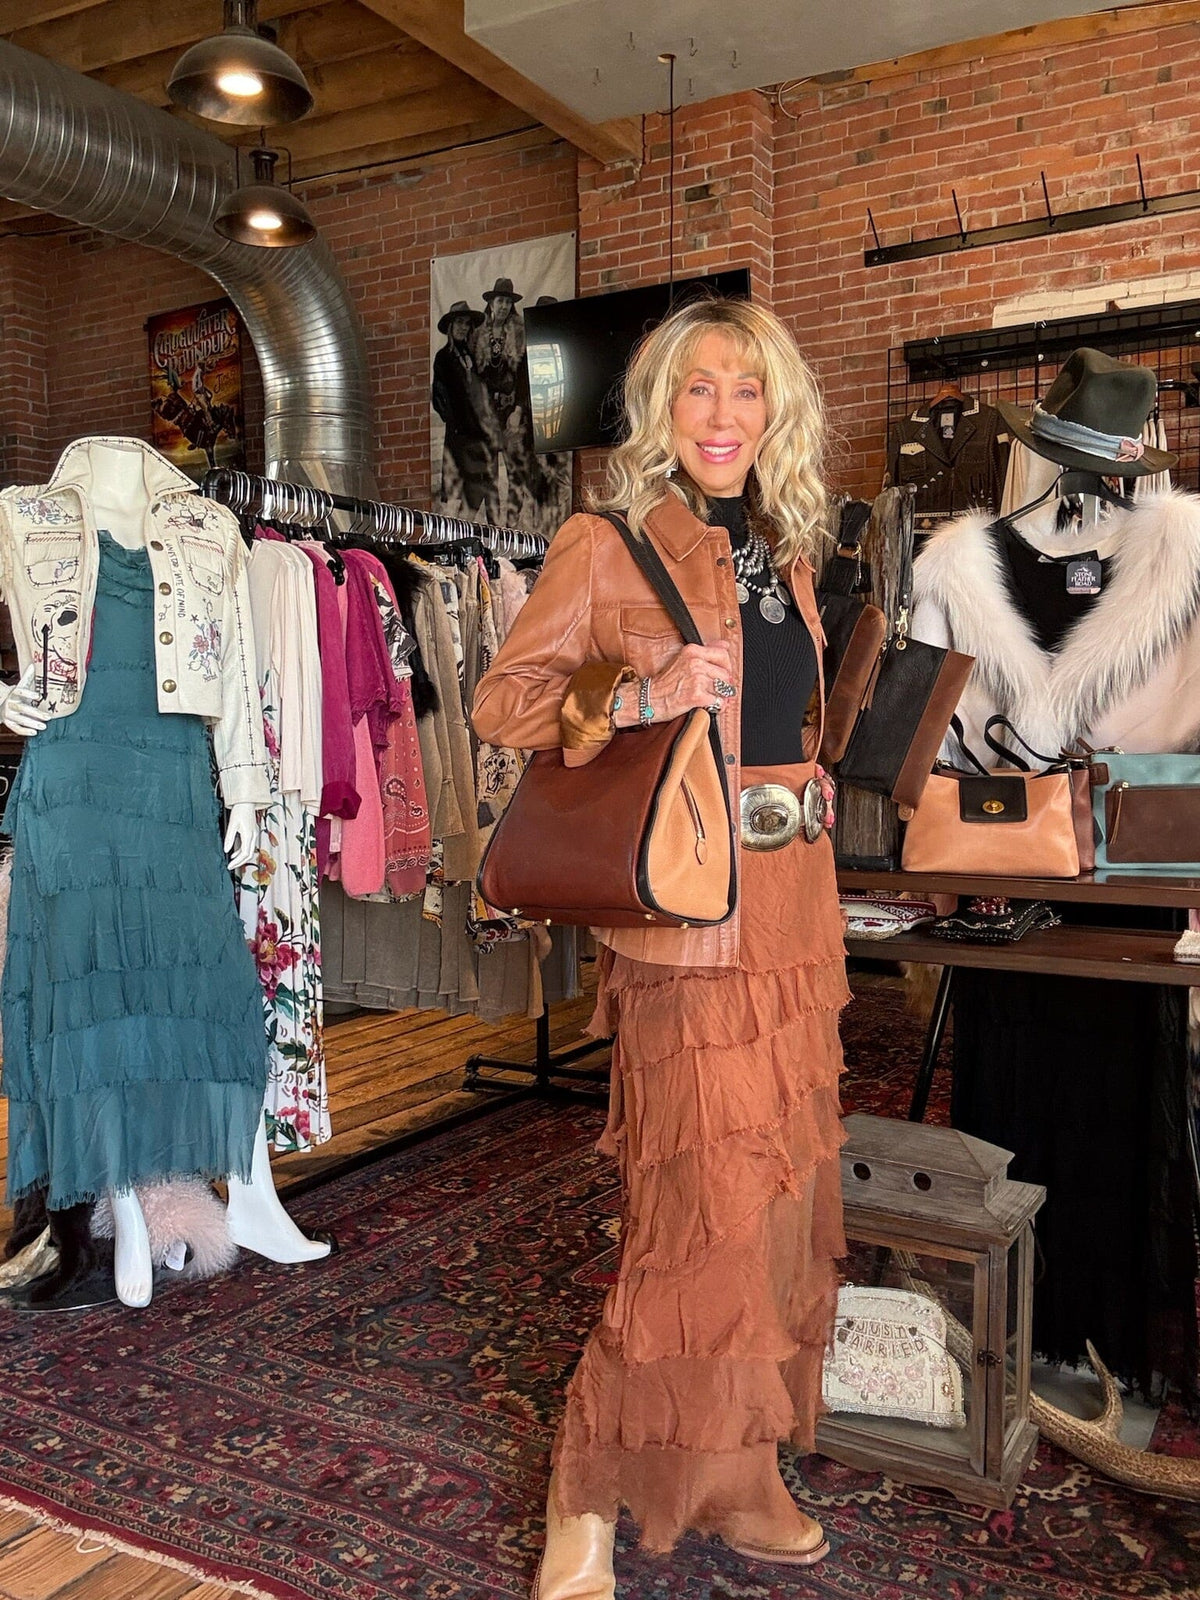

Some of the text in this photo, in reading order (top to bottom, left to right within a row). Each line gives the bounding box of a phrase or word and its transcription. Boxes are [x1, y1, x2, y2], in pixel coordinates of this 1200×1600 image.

[167, 331, 229, 376] ROUNDUP
[176, 588, 185, 599] OF
[177, 599, 186, 618] MIND
[855, 1321, 905, 1338] JUST
